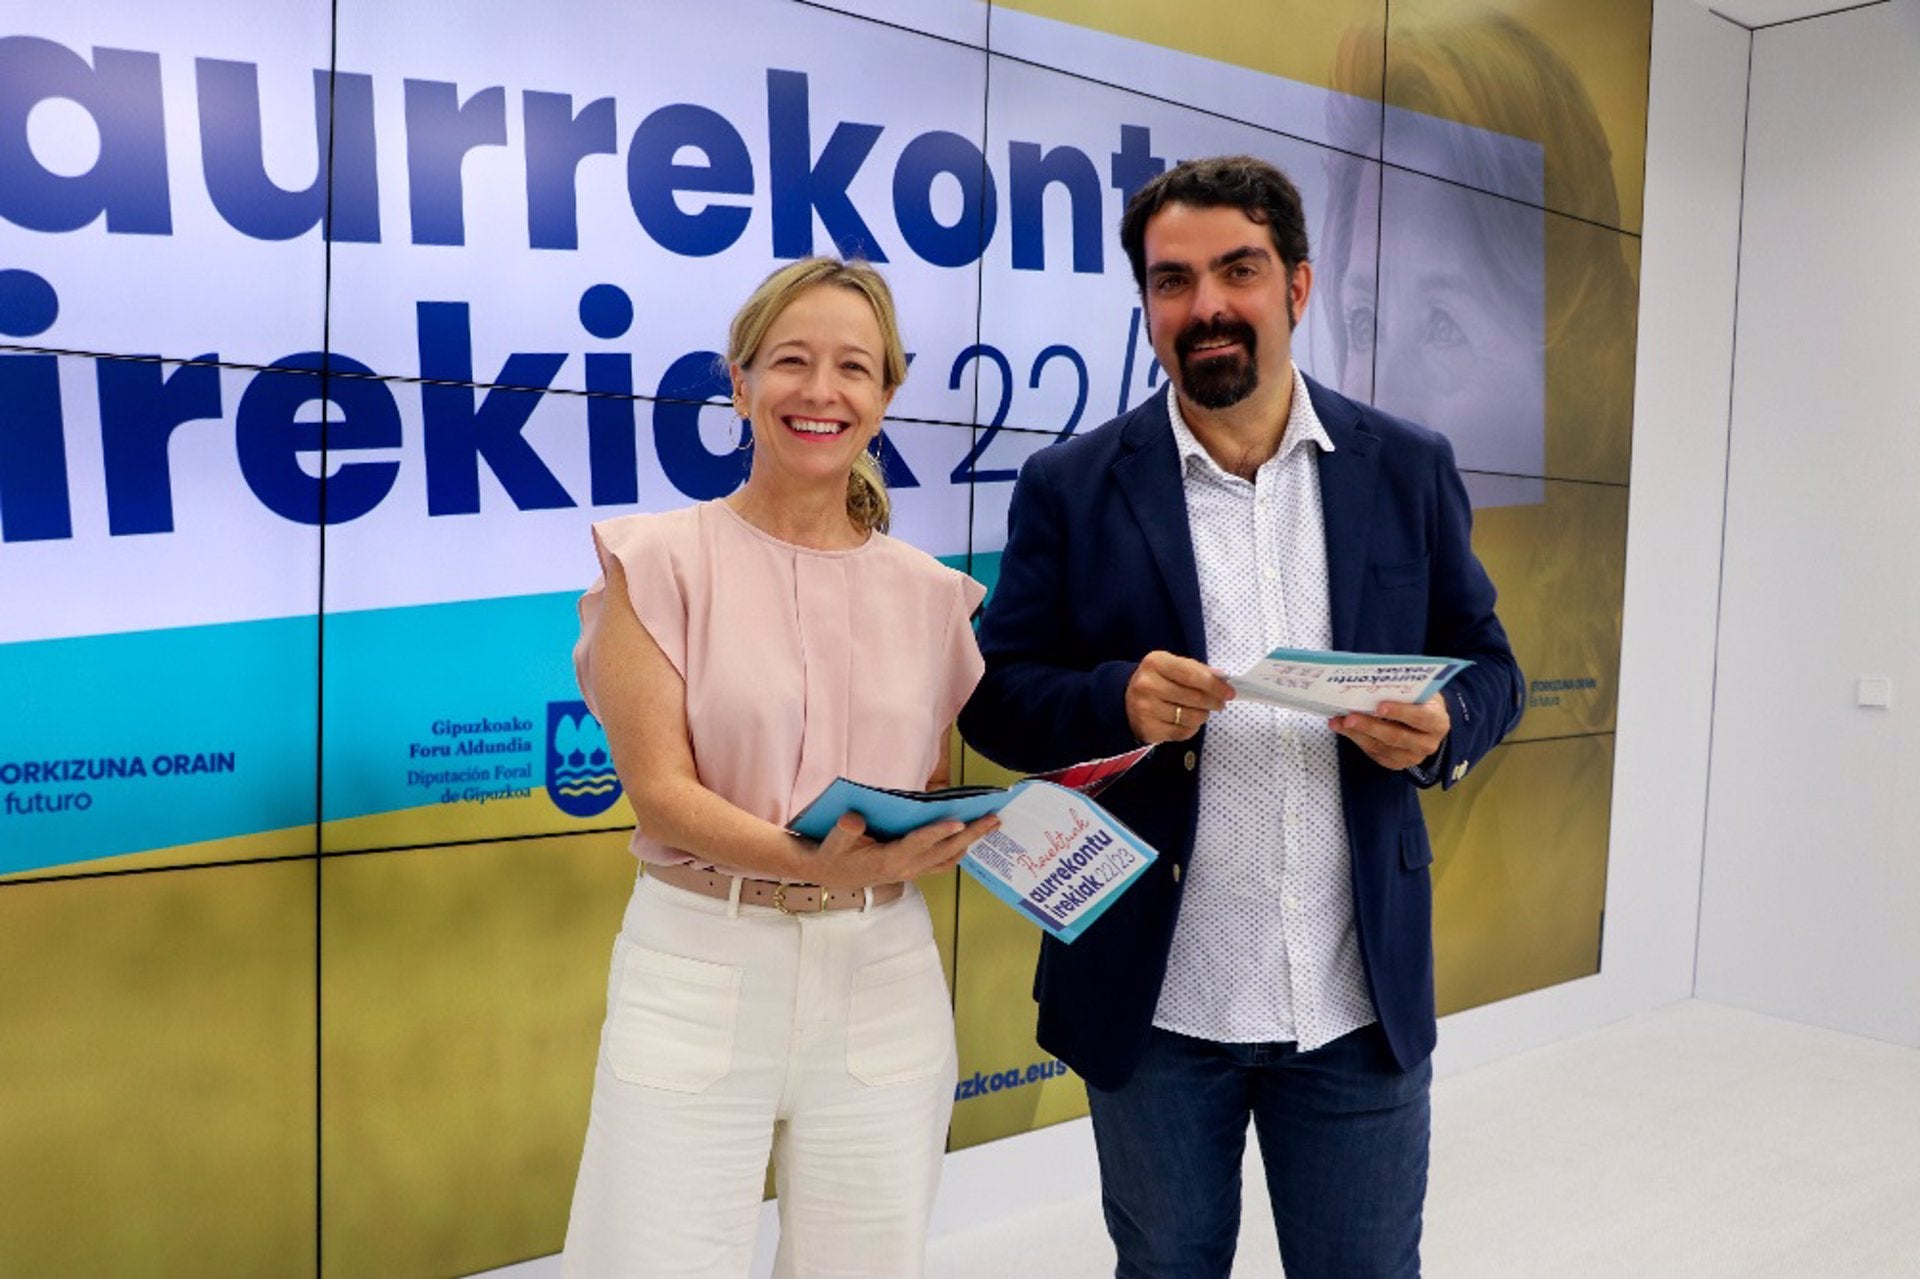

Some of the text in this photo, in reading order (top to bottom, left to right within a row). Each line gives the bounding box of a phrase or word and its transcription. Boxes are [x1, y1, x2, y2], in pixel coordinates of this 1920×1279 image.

[431, 716, 533, 738] Gipuzkoako
[409, 737, 532, 759] Foru Aldundia
[152, 751, 236, 777] ORAIN
[407, 763, 532, 788] Diputación Foral
[4, 790, 93, 815] futuro
[441, 786, 532, 805] de Gipuzkoa
[1028, 829, 1114, 904] aurrekontu
[1045, 847, 1136, 919] irekiak 22/23
